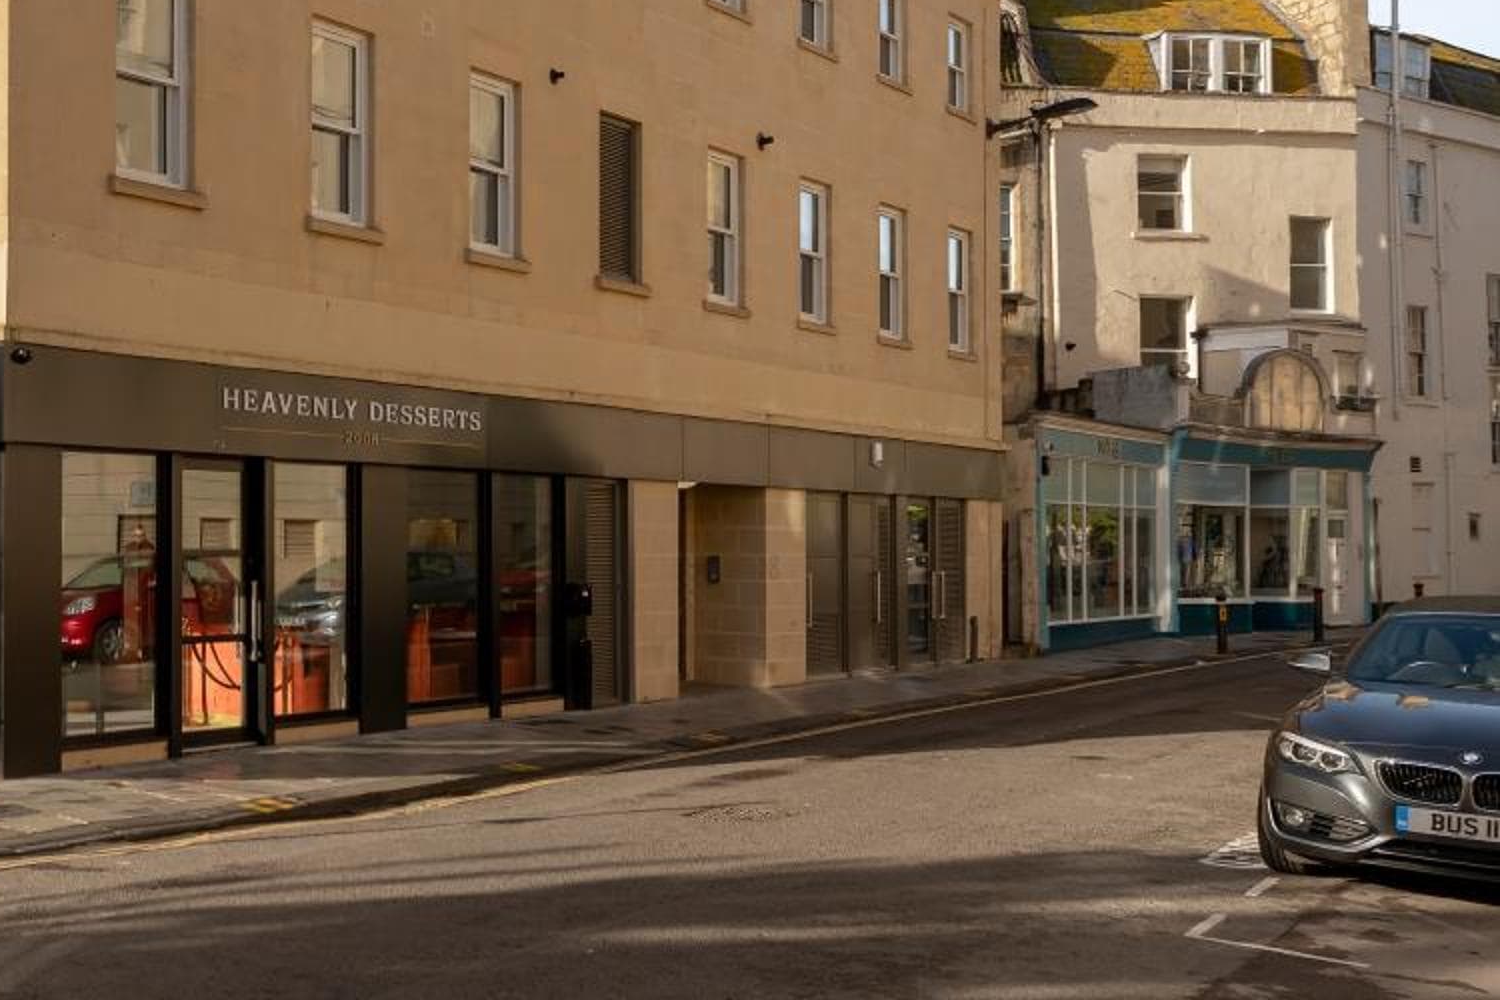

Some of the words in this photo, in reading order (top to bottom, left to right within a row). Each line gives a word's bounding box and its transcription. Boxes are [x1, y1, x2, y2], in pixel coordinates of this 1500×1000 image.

[223, 387, 357, 420] HEAVENLY
[369, 401, 481, 431] DESSERTS
[1431, 813, 1478, 836] BUS
